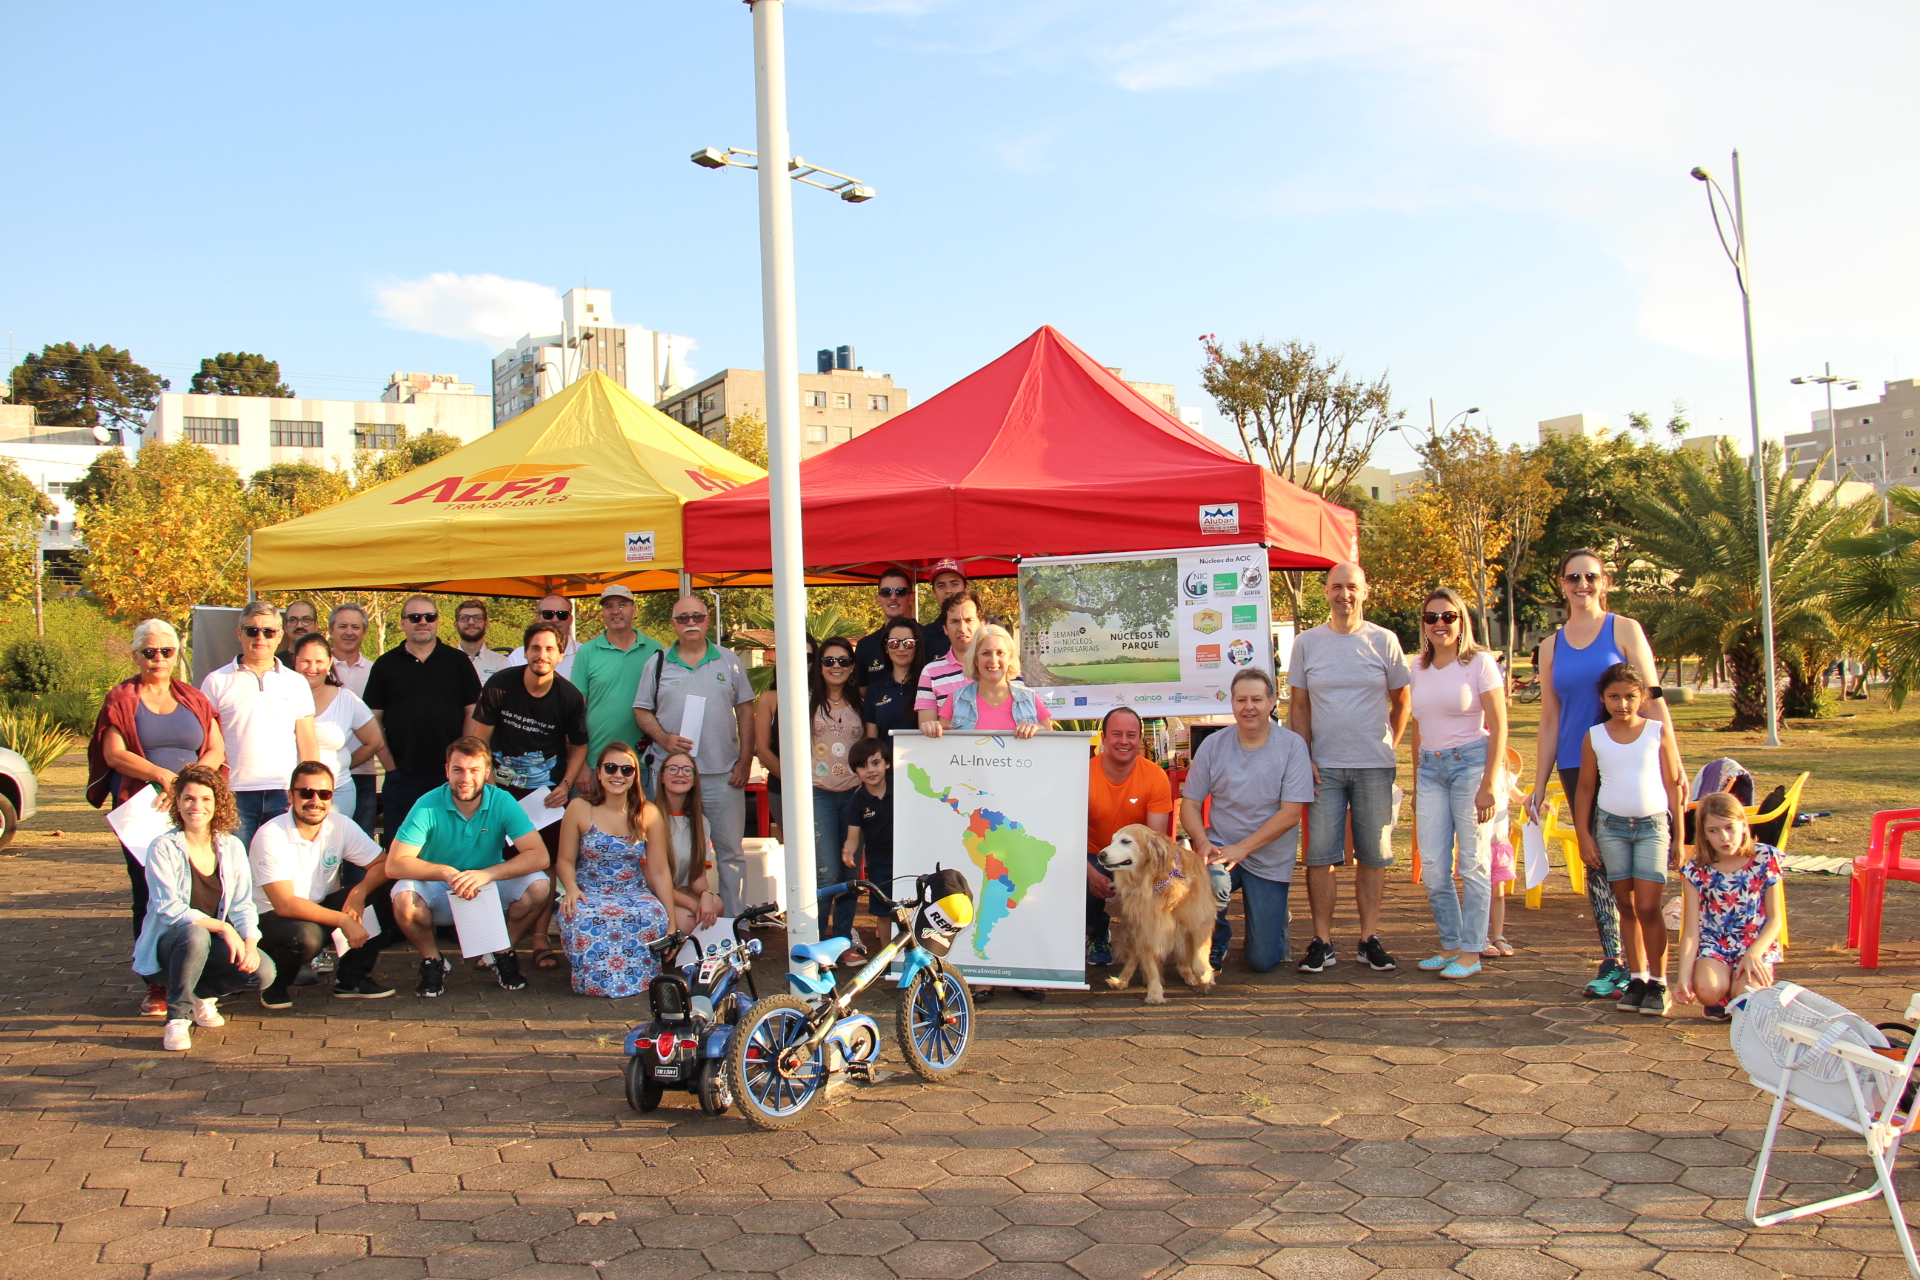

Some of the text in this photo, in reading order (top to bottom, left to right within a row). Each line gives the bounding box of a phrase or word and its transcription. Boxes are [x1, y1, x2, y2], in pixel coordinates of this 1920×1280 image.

[388, 476, 572, 506] ALFA
[442, 494, 573, 511] TRANSPORTES
[1203, 517, 1235, 525] Aluban
[1199, 557, 1224, 565] Núcleos
[1052, 631, 1080, 639] SEMANA
[1110, 630, 1171, 641] NÚCLEOS NO
[1062, 637, 1093, 645] NÚCLEOS
[1053, 645, 1100, 654] EMPRESARIAIS
[1121, 641, 1160, 651] PARQUE
[1134, 694, 1162, 702] cainco
[949, 754, 1012, 768] AL-Invest
[962, 967, 1012, 976] www.alinvest5.org
